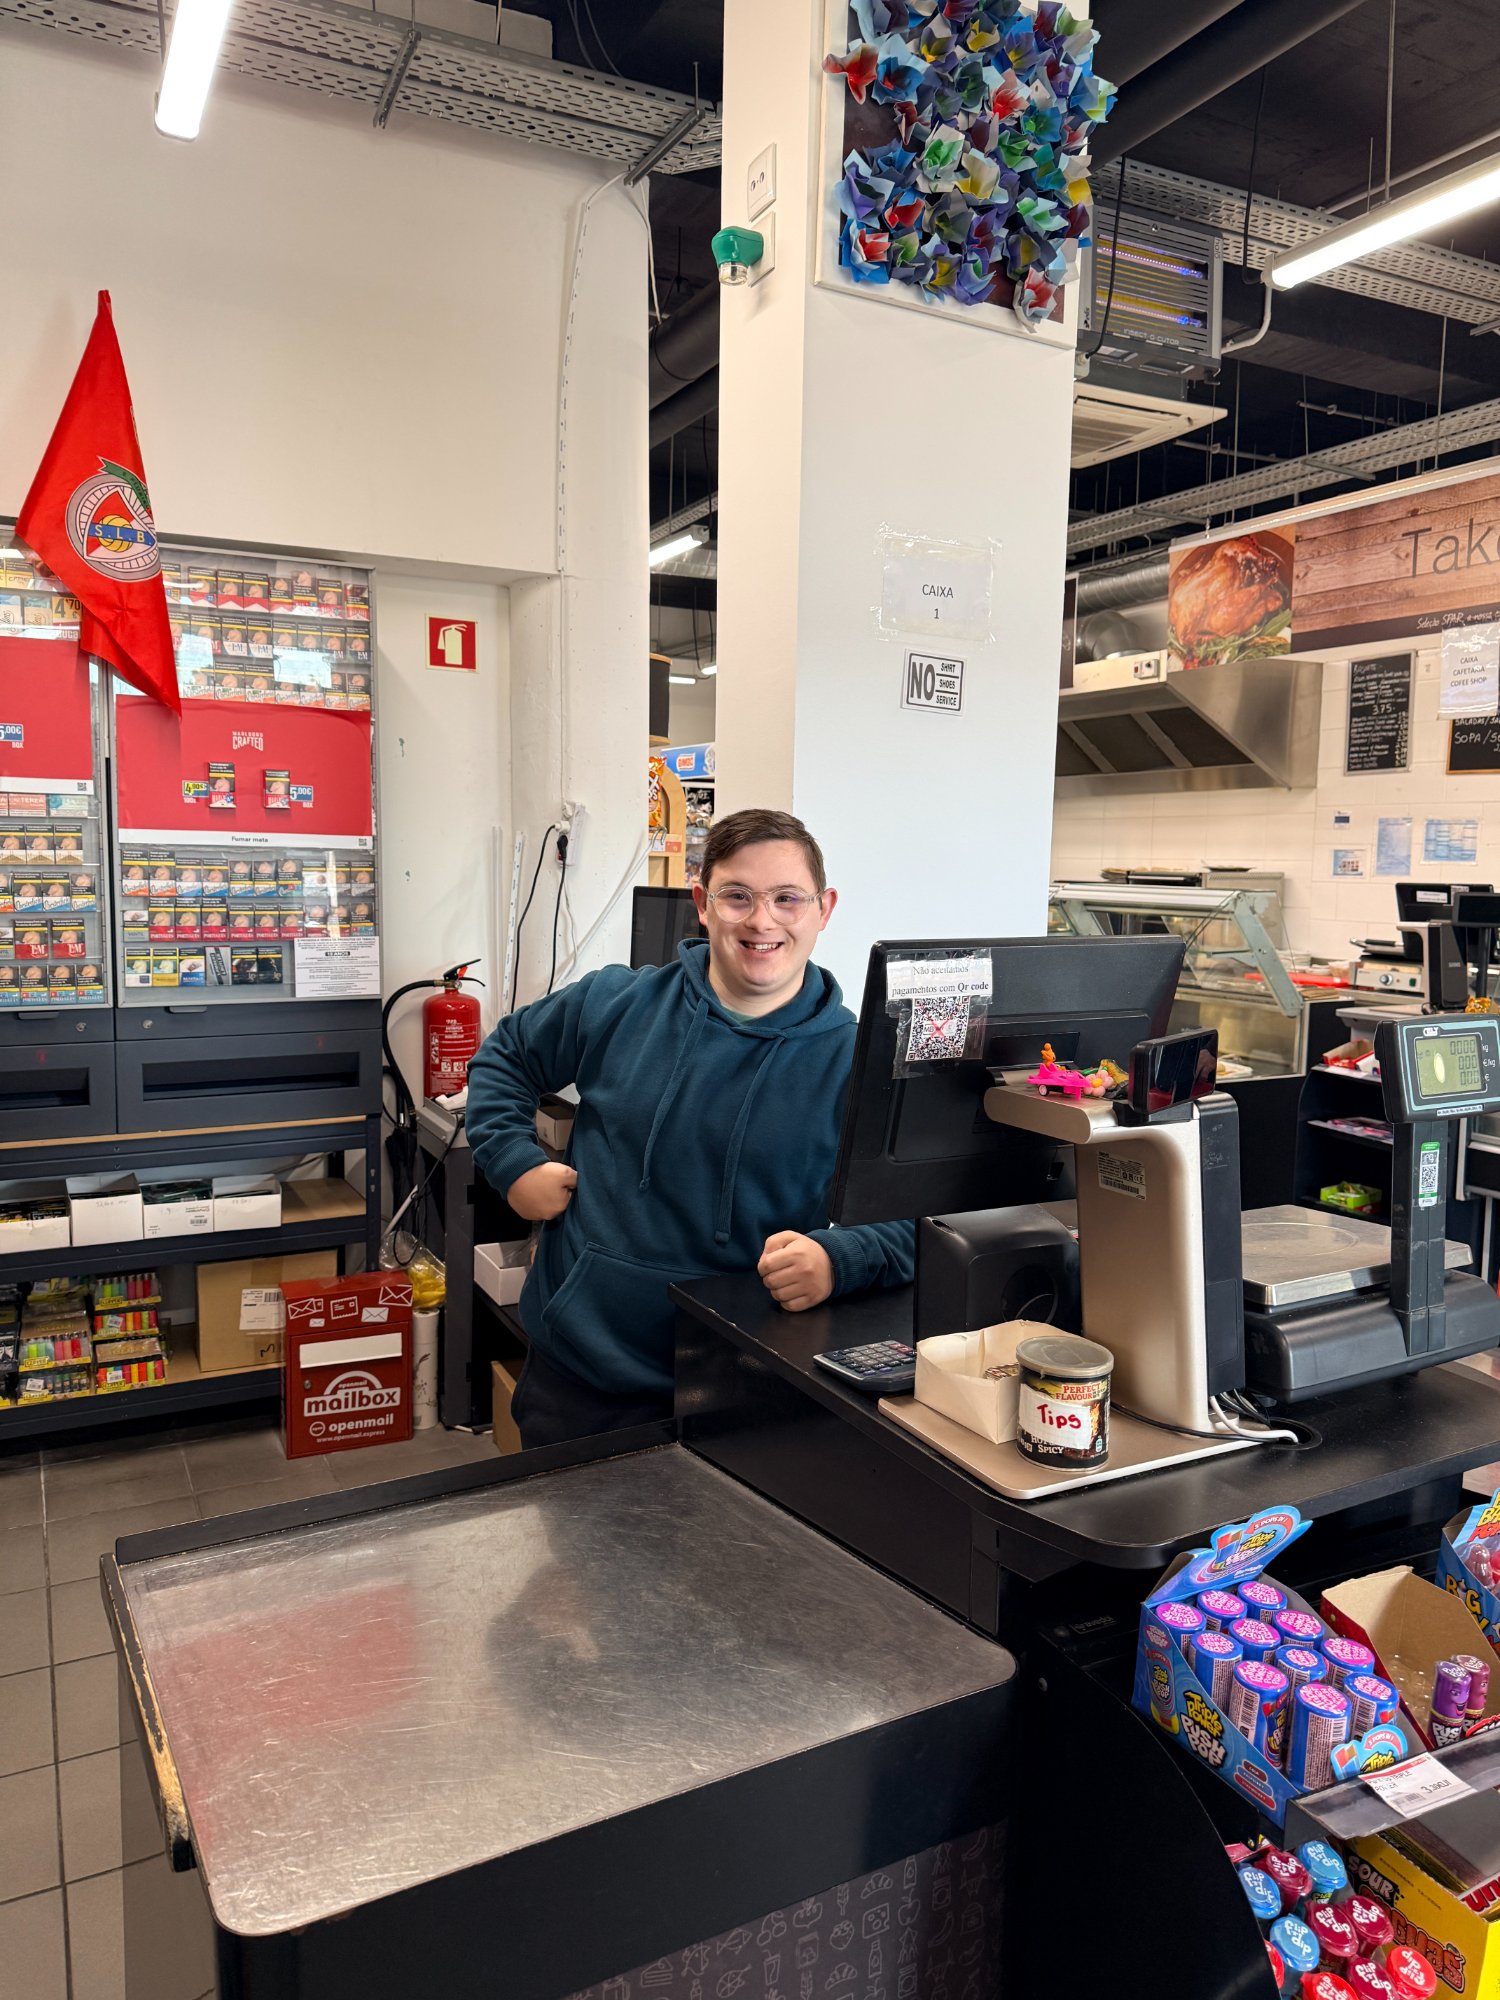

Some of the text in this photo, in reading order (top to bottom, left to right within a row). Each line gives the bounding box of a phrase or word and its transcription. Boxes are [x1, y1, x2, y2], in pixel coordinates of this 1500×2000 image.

[1402, 517, 1500, 578] Tak
[922, 584, 954, 599] CAIXA
[933, 608, 940, 620] 1
[940, 662, 956, 674] SHIRT
[1460, 656, 1479, 665] CAIXA
[910, 661, 936, 701] NO
[939, 679, 956, 690] SHOES
[1470, 677, 1487, 686] SHOP
[936, 694, 957, 707] SERVICE
[232, 736, 264, 751] CRAFTED
[1454, 731, 1481, 745] SOPA
[913, 966, 930, 976] Não
[892, 986, 937, 997] pagamentos
[957, 981, 969, 993] Qr
[970, 981, 989, 991] code
[1063, 1382, 1101, 1394] PERFECT
[307, 1390, 397, 1413] mailbox
[1055, 1392, 1093, 1401] FLAVOUR
[328, 1413, 394, 1434] openmail
[1037, 1403, 1082, 1429] Tips
[1038, 1444, 1065, 1454] SPICY
[1183, 1690, 1224, 1731] Triple
[1187, 1700, 1221, 1738] Power
[1331, 1921, 1352, 1939] dip
[1291, 1932, 1312, 1956] dip
